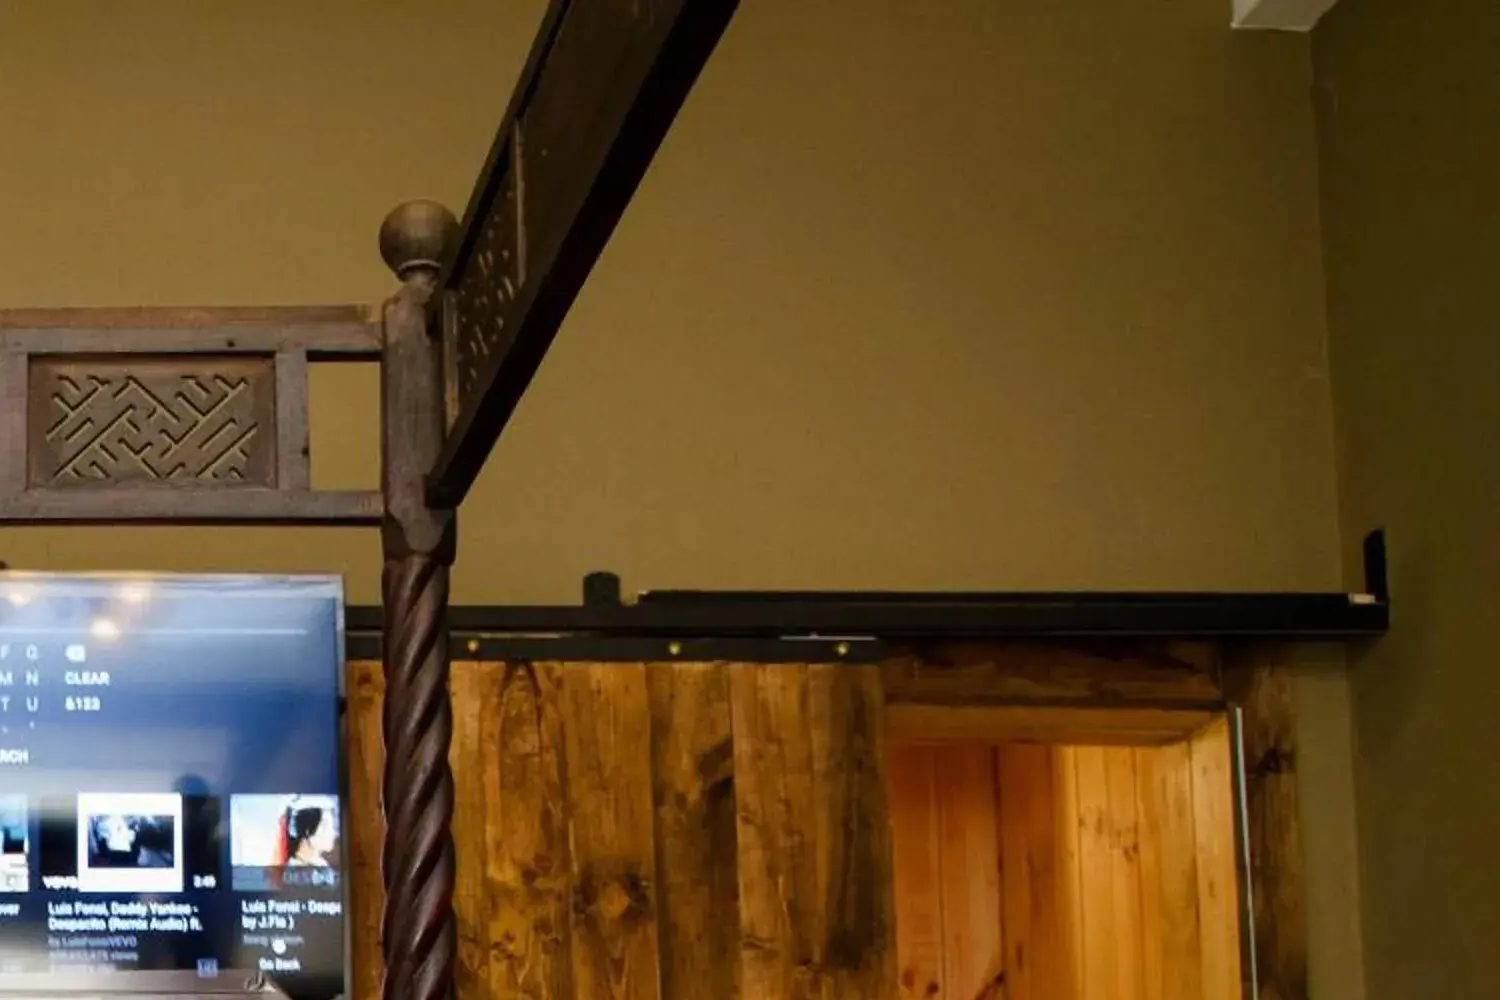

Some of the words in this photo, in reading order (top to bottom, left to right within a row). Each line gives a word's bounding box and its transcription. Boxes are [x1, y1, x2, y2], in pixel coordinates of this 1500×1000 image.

[26, 670, 39, 686] N
[65, 671, 110, 686] CLEAR
[0, 696, 11, 712] T
[27, 696, 39, 712] U
